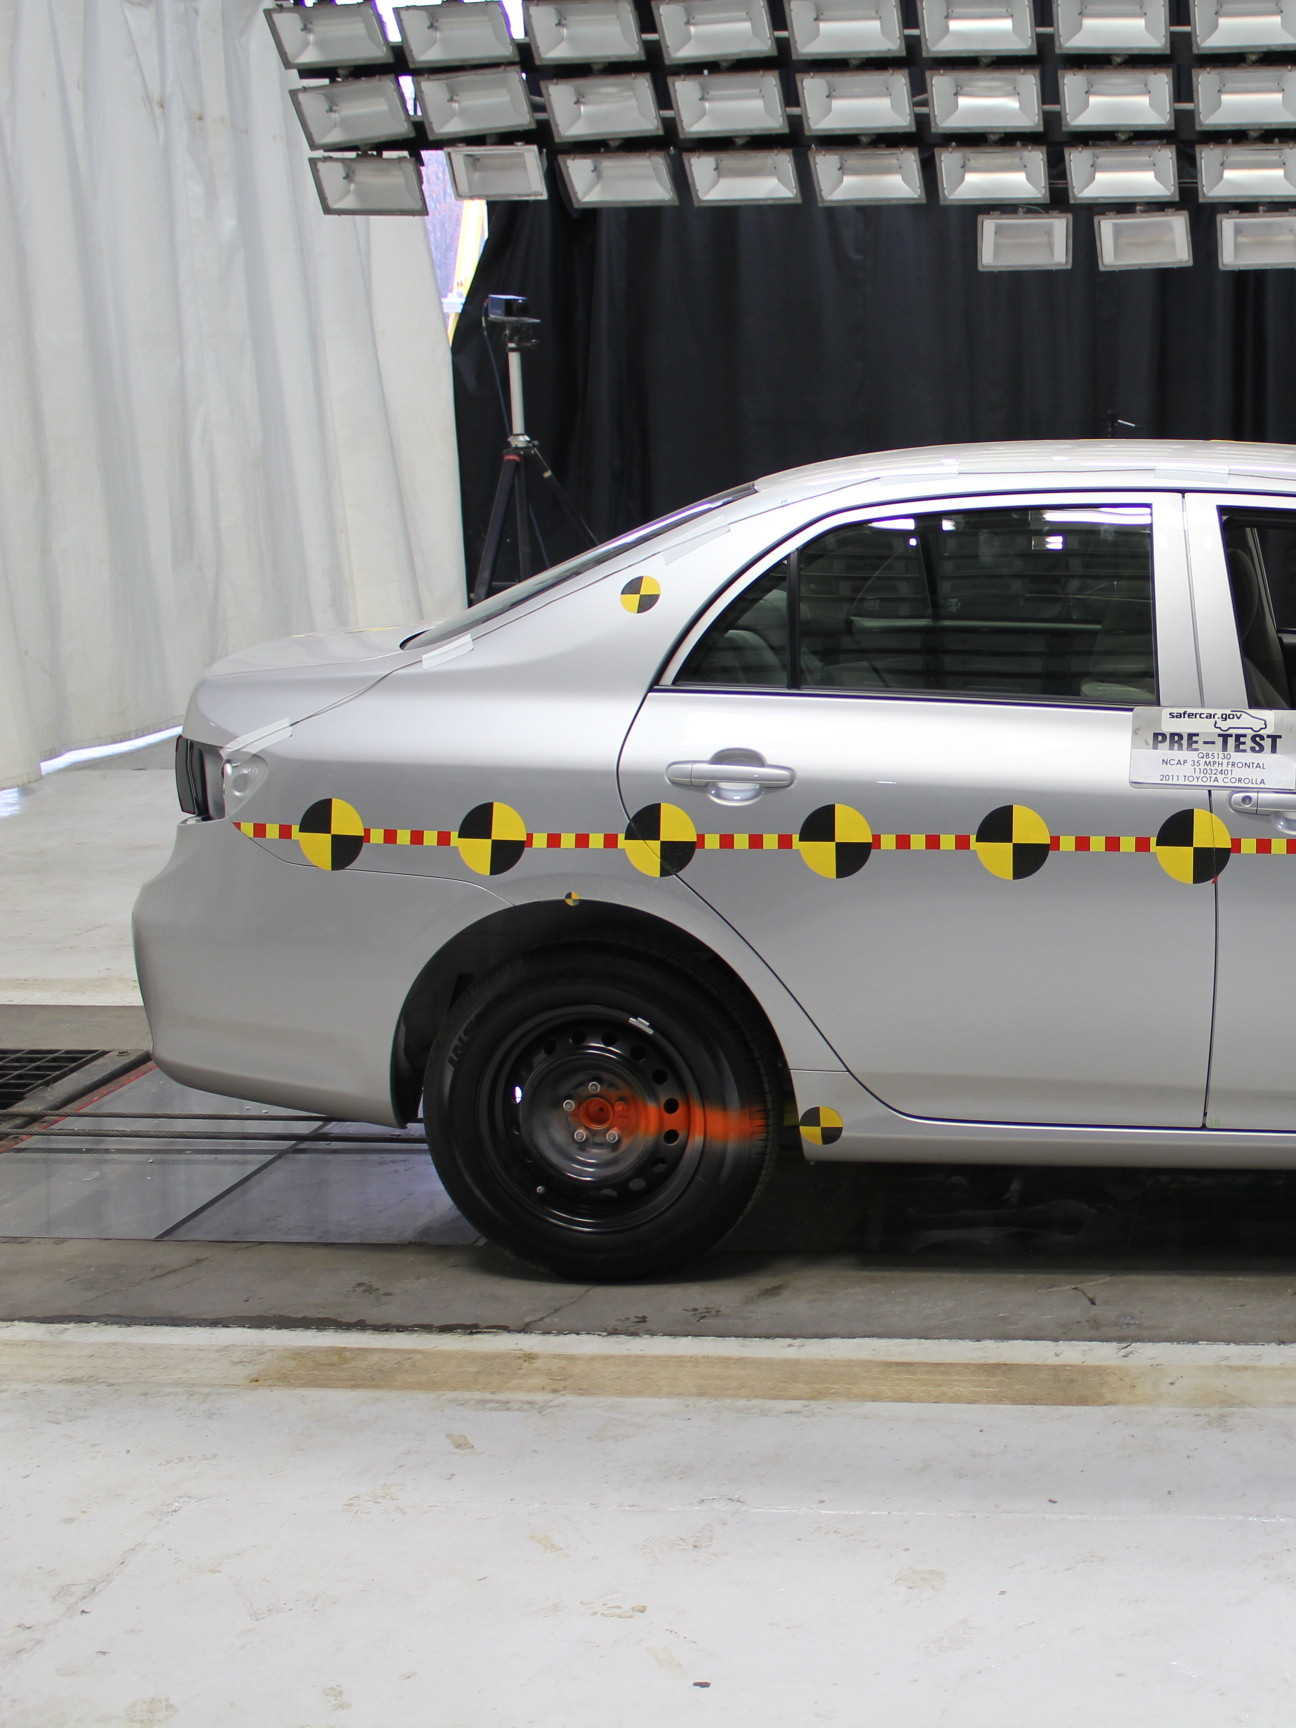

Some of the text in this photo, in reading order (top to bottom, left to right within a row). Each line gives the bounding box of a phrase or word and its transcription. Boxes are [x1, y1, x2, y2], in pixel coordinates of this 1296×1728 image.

[1168, 710, 1243, 721] safercar.gov
[1152, 732, 1283, 754] PRE-TEST
[1197, 751, 1232, 761] QB5130
[1161, 758, 1266, 770] NCAP 35 MPH FRONTAL
[1193, 767, 1233, 776] 11032401
[1159, 774, 1266, 786] 2011 TOYOTA COROLLA
